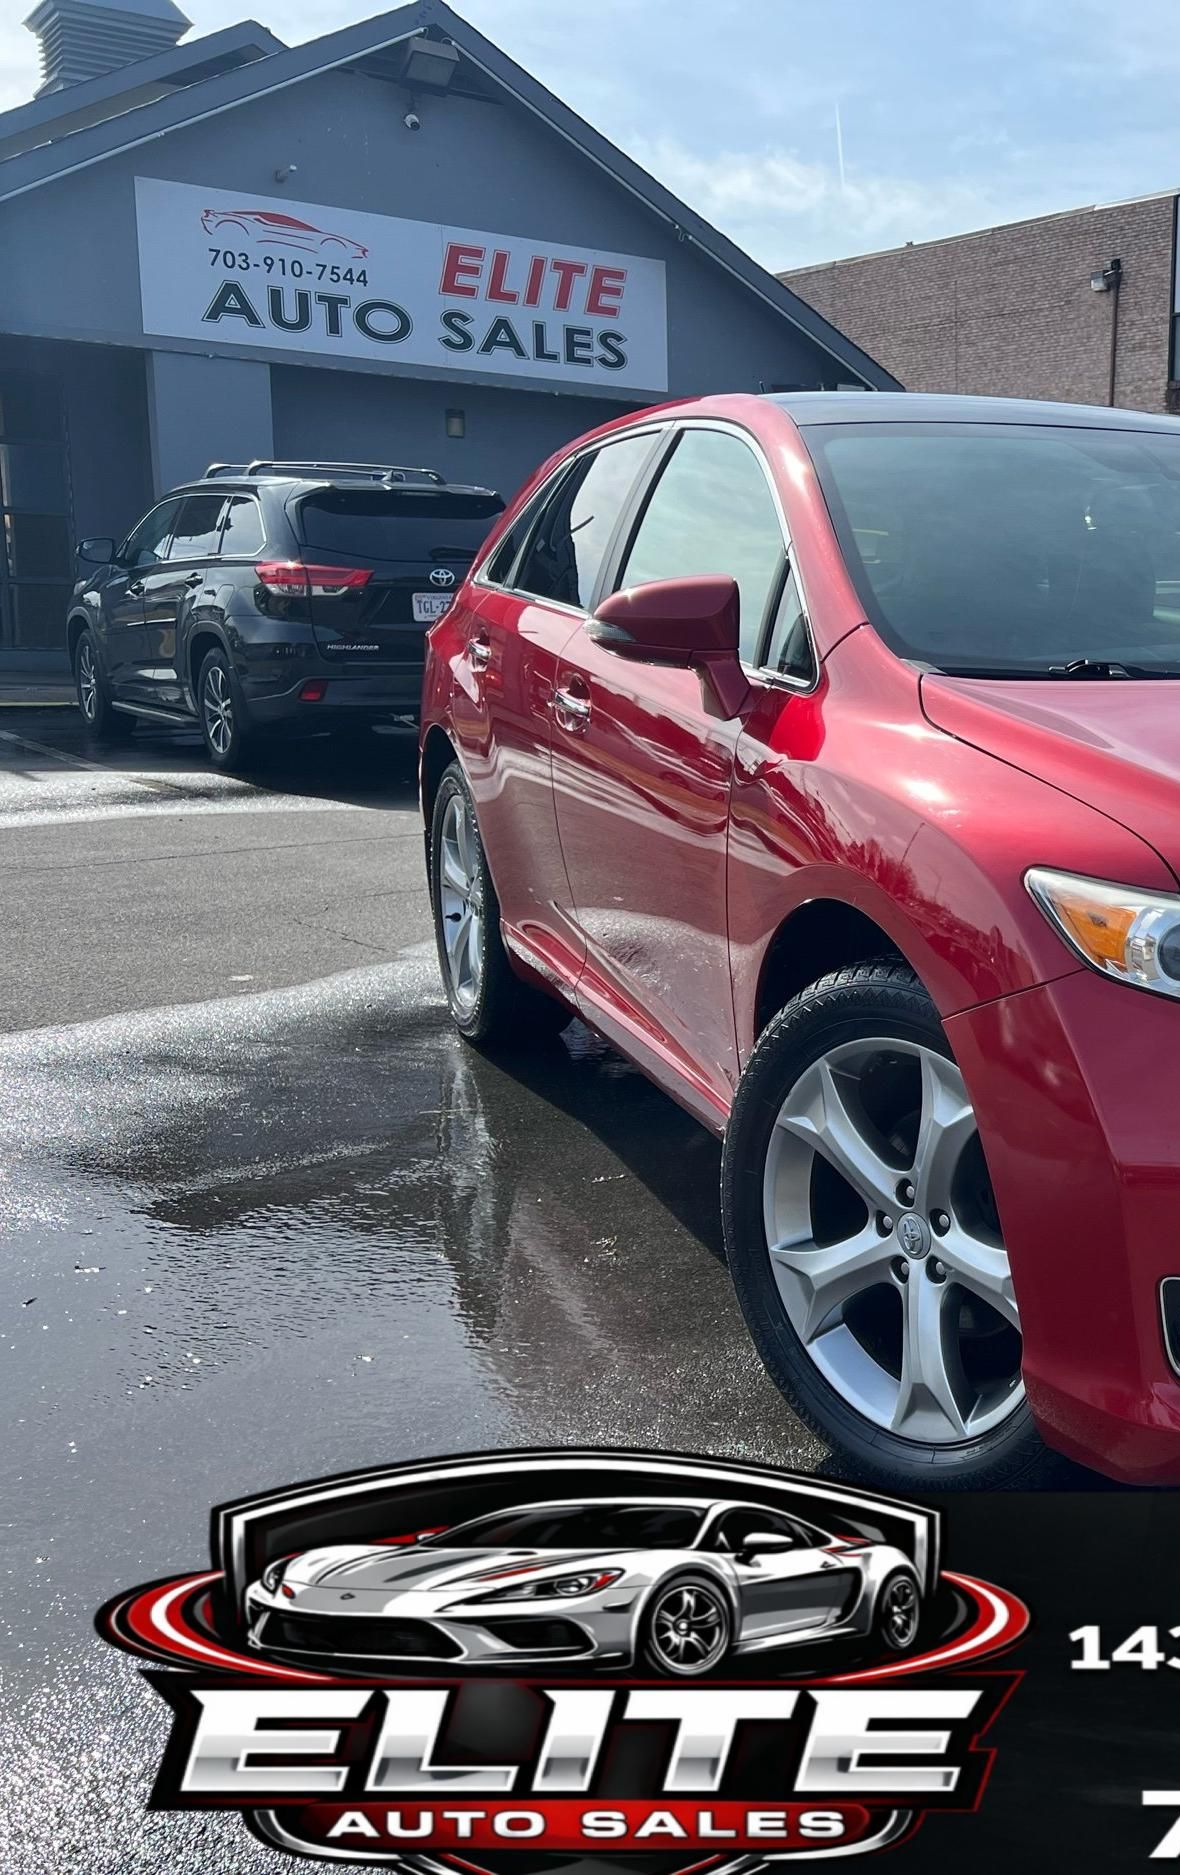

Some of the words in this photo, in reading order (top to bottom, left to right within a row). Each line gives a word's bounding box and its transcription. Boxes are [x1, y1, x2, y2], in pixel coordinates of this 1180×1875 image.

[207, 248, 369, 287] 703-910-7544
[439, 242, 628, 318] ELITE
[201, 279, 413, 344] AUTO
[438, 308, 628, 370] SALES
